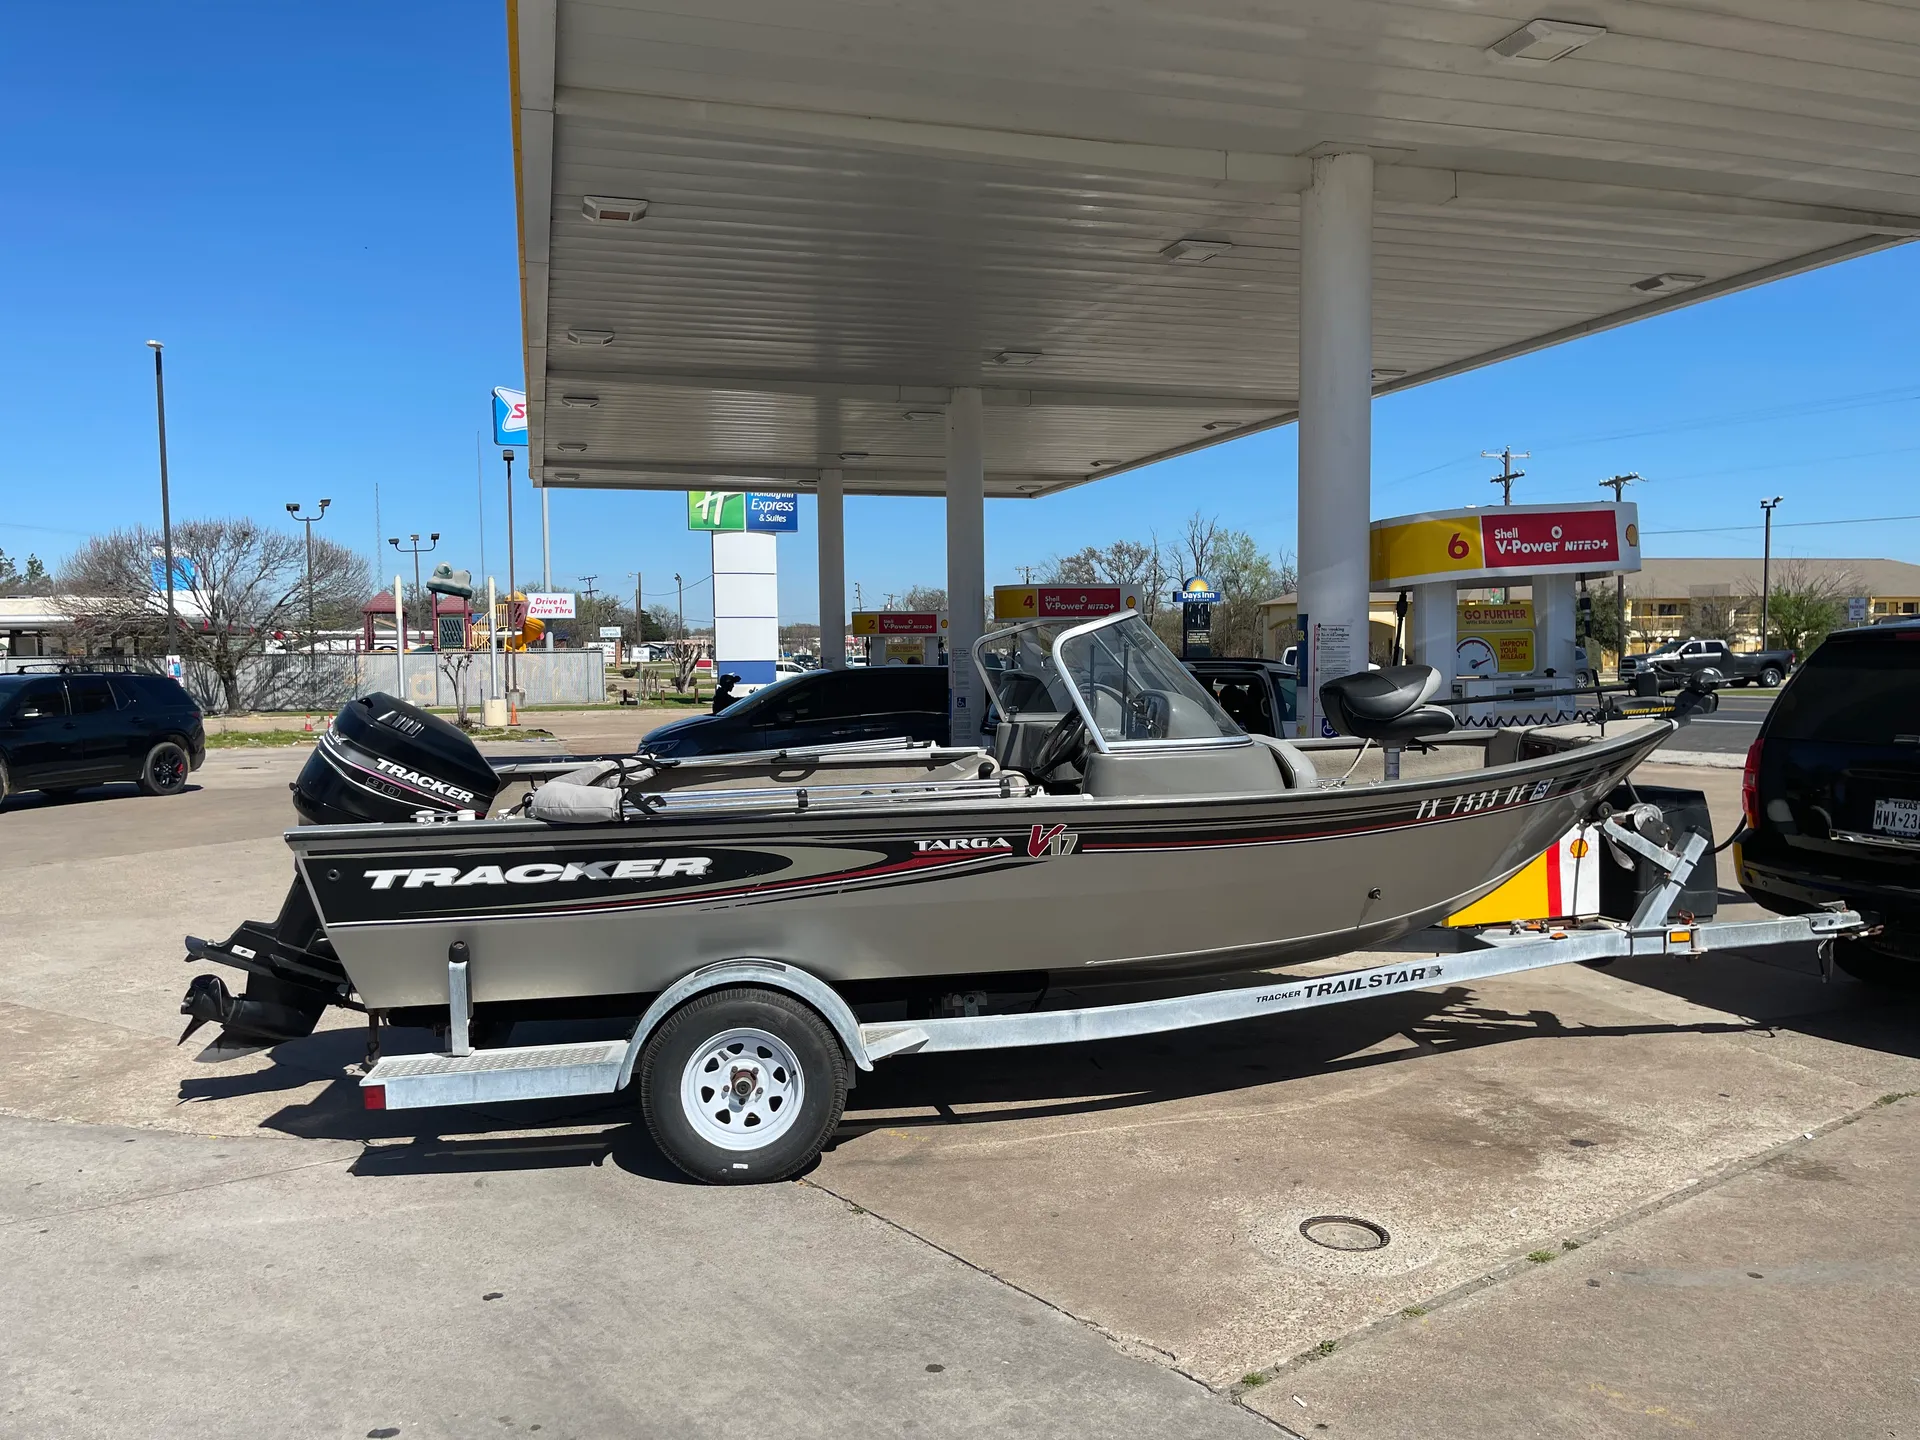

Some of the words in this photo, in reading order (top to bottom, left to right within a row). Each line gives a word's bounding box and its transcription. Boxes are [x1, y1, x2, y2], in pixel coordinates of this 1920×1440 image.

[751, 498, 794, 514] Express
[766, 513, 787, 523] Suites
[1494, 527, 1519, 540] Shell
[1447, 532, 1470, 560] 6
[1495, 540, 1559, 555] V-Power
[535, 596, 558, 605] Drive
[559, 597, 568, 605] In
[1022, 594, 1035, 609] 4
[1044, 594, 1060, 602] Shell
[530, 606, 553, 614] Drive
[554, 606, 573, 614] Thru
[1045, 602, 1084, 610] V-Power
[1464, 609, 1481, 620] GO
[1484, 608, 1527, 620] FURTHER
[868, 619, 876, 630] 2
[365, 775, 402, 798] 90
[376, 757, 474, 803] TRACKER
[1415, 798, 1441, 820] TX
[1451, 789, 1500, 815] 7533
[1504, 783, 1529, 805] DE
[1893, 801, 1918, 811] TEXAS
[914, 837, 1014, 851] TARGA
[363, 857, 713, 890] TRACKER
[1256, 990, 1301, 1003] TRACKER
[1303, 967, 1426, 999] TRAILSTAR
